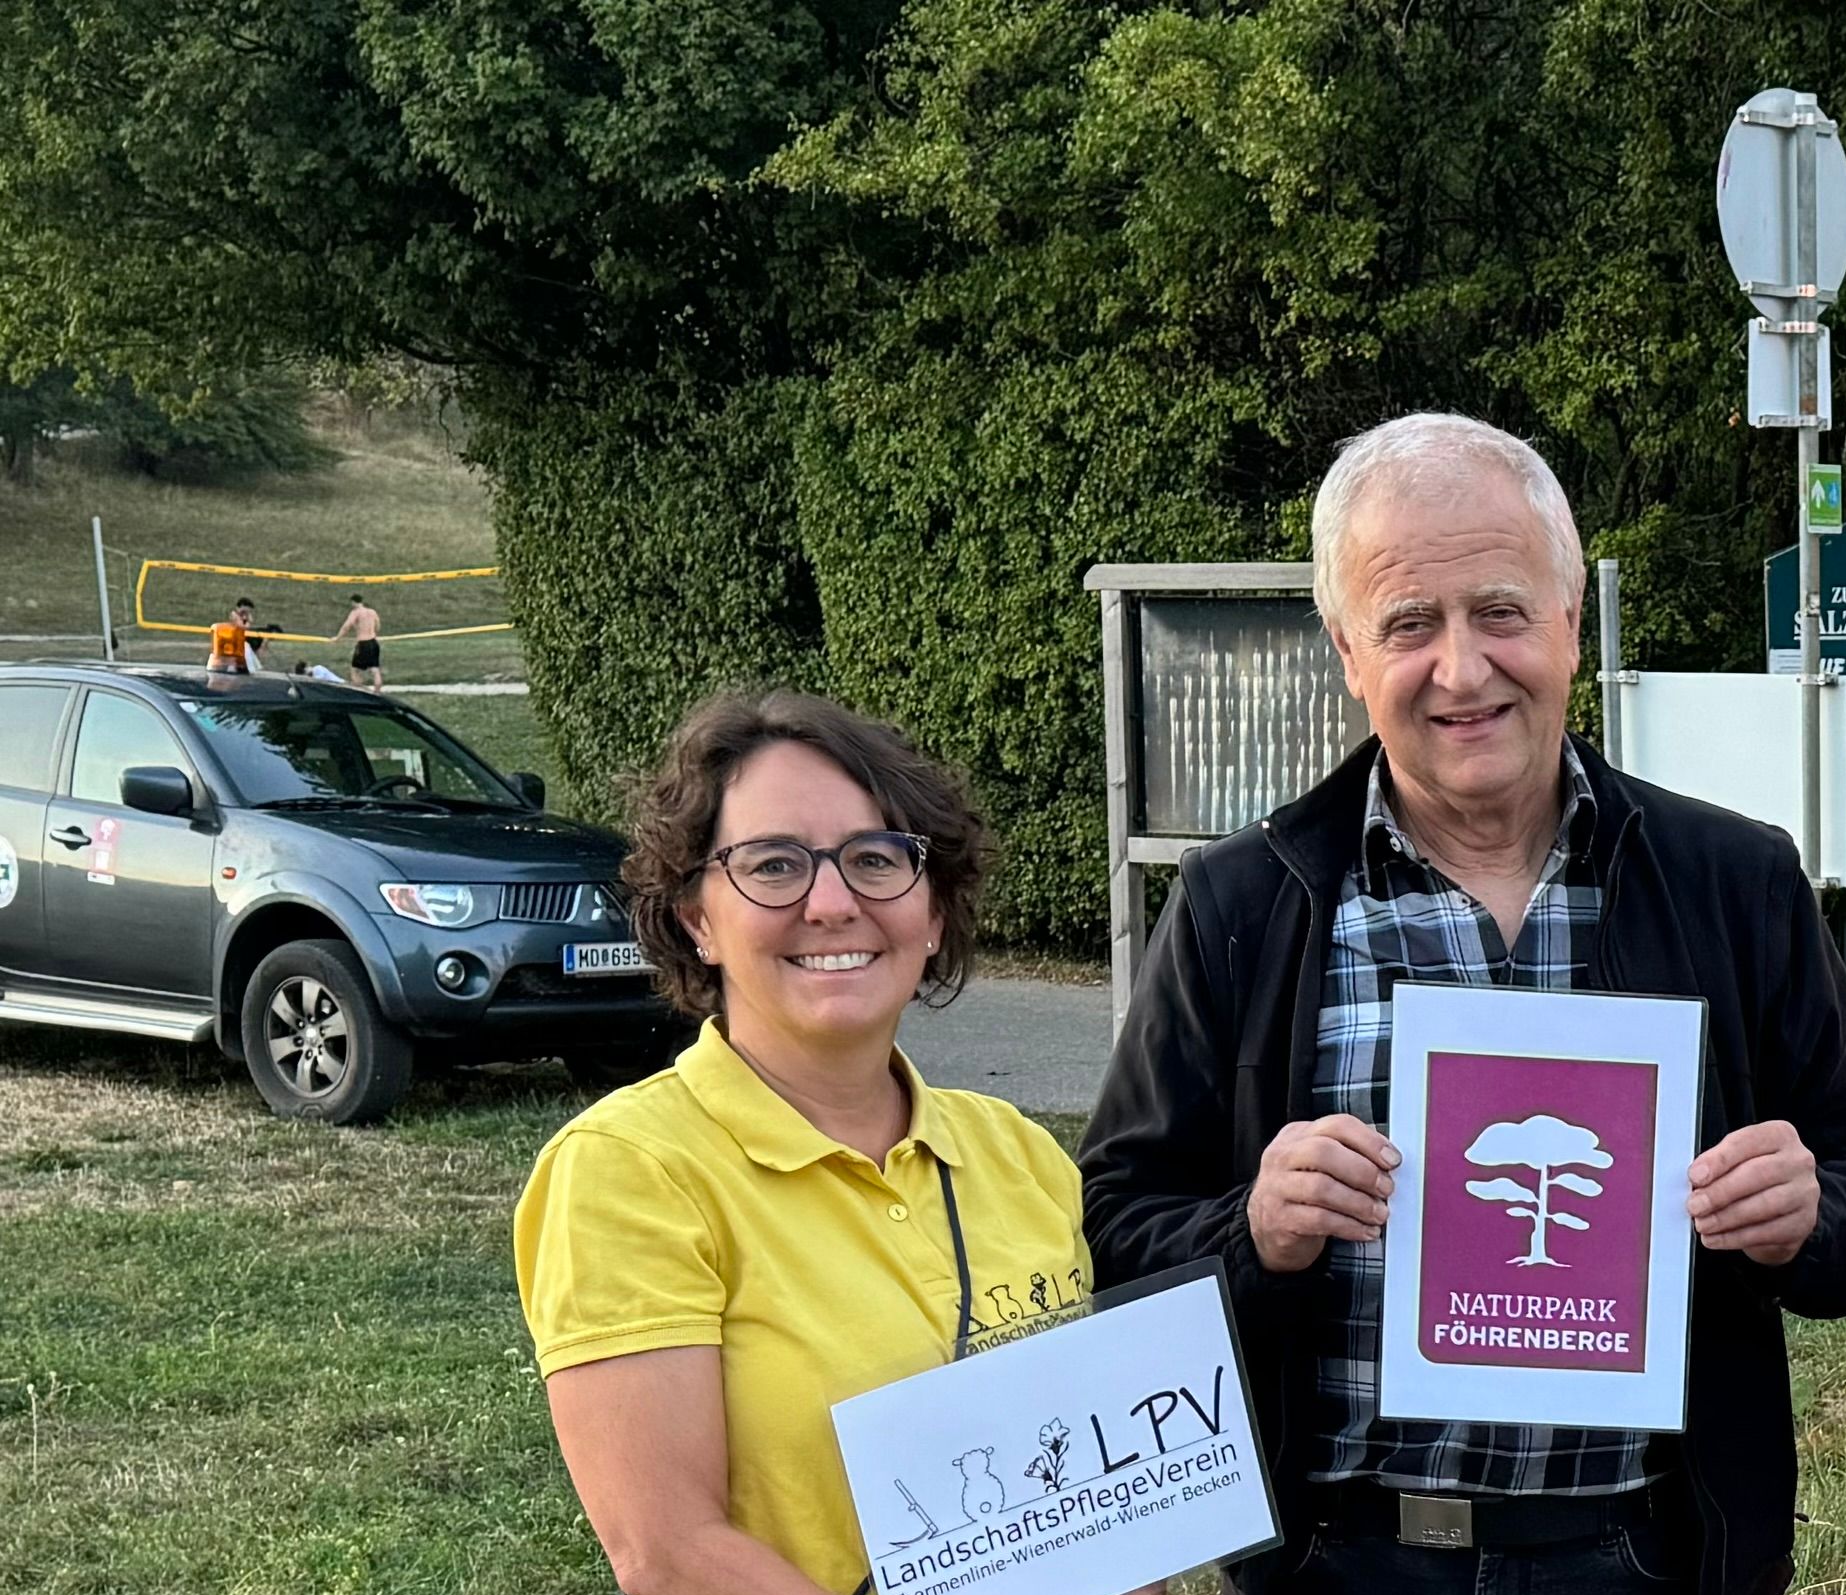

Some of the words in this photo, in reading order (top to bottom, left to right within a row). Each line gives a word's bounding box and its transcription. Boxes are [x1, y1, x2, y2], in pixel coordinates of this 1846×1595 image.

[1819, 658, 1846, 674] UF
[1449, 1291, 1618, 1323] NATURPARK
[1434, 1320, 1630, 1354] FÖHRENBERGE
[1091, 1365, 1225, 1474] LPV
[1182, 1469, 1242, 1503] Becken
[881, 1440, 1237, 1590] LandschaftsPflegeVerein
